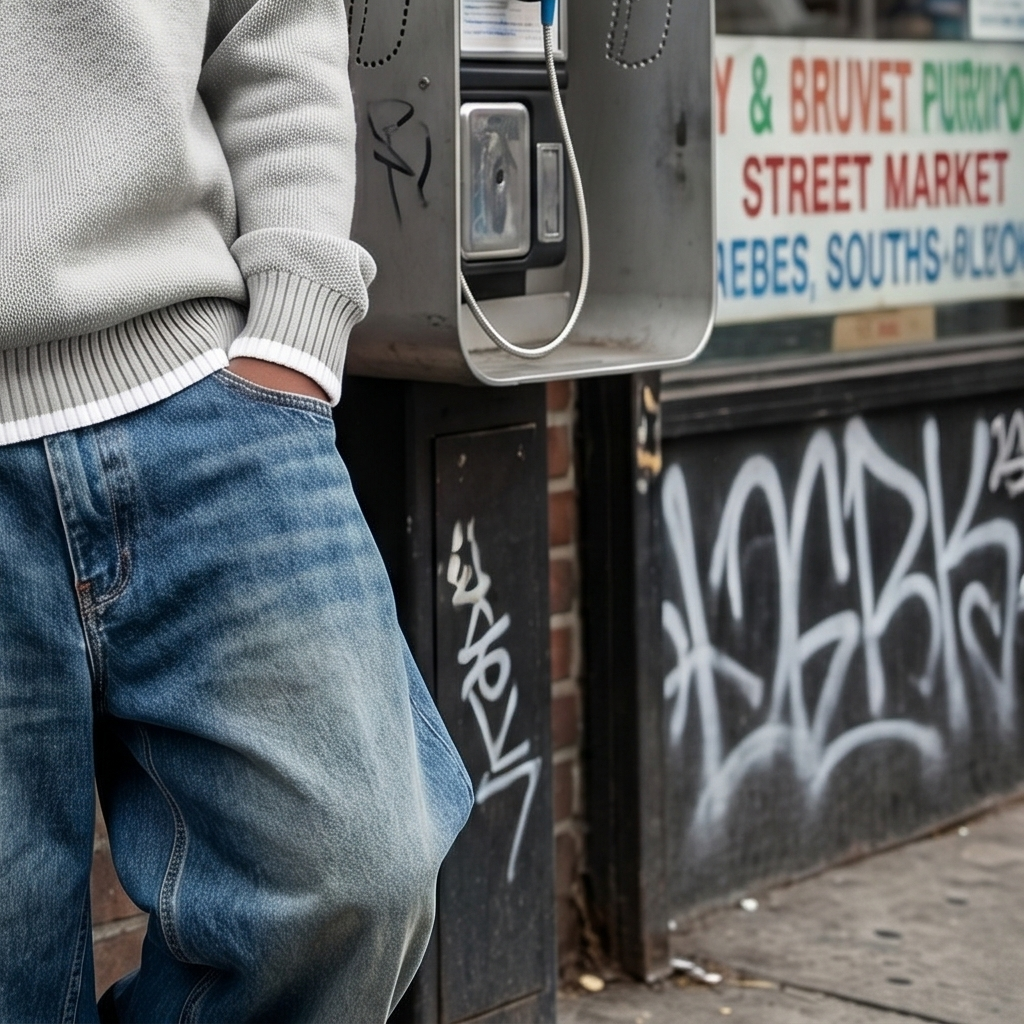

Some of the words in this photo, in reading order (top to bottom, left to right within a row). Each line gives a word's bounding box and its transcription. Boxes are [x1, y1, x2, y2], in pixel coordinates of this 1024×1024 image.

[749, 53, 774, 136] &
[789, 56, 913, 134] BRUVET
[742, 155, 872, 219] STREET
[884, 150, 1010, 211] MARKET
